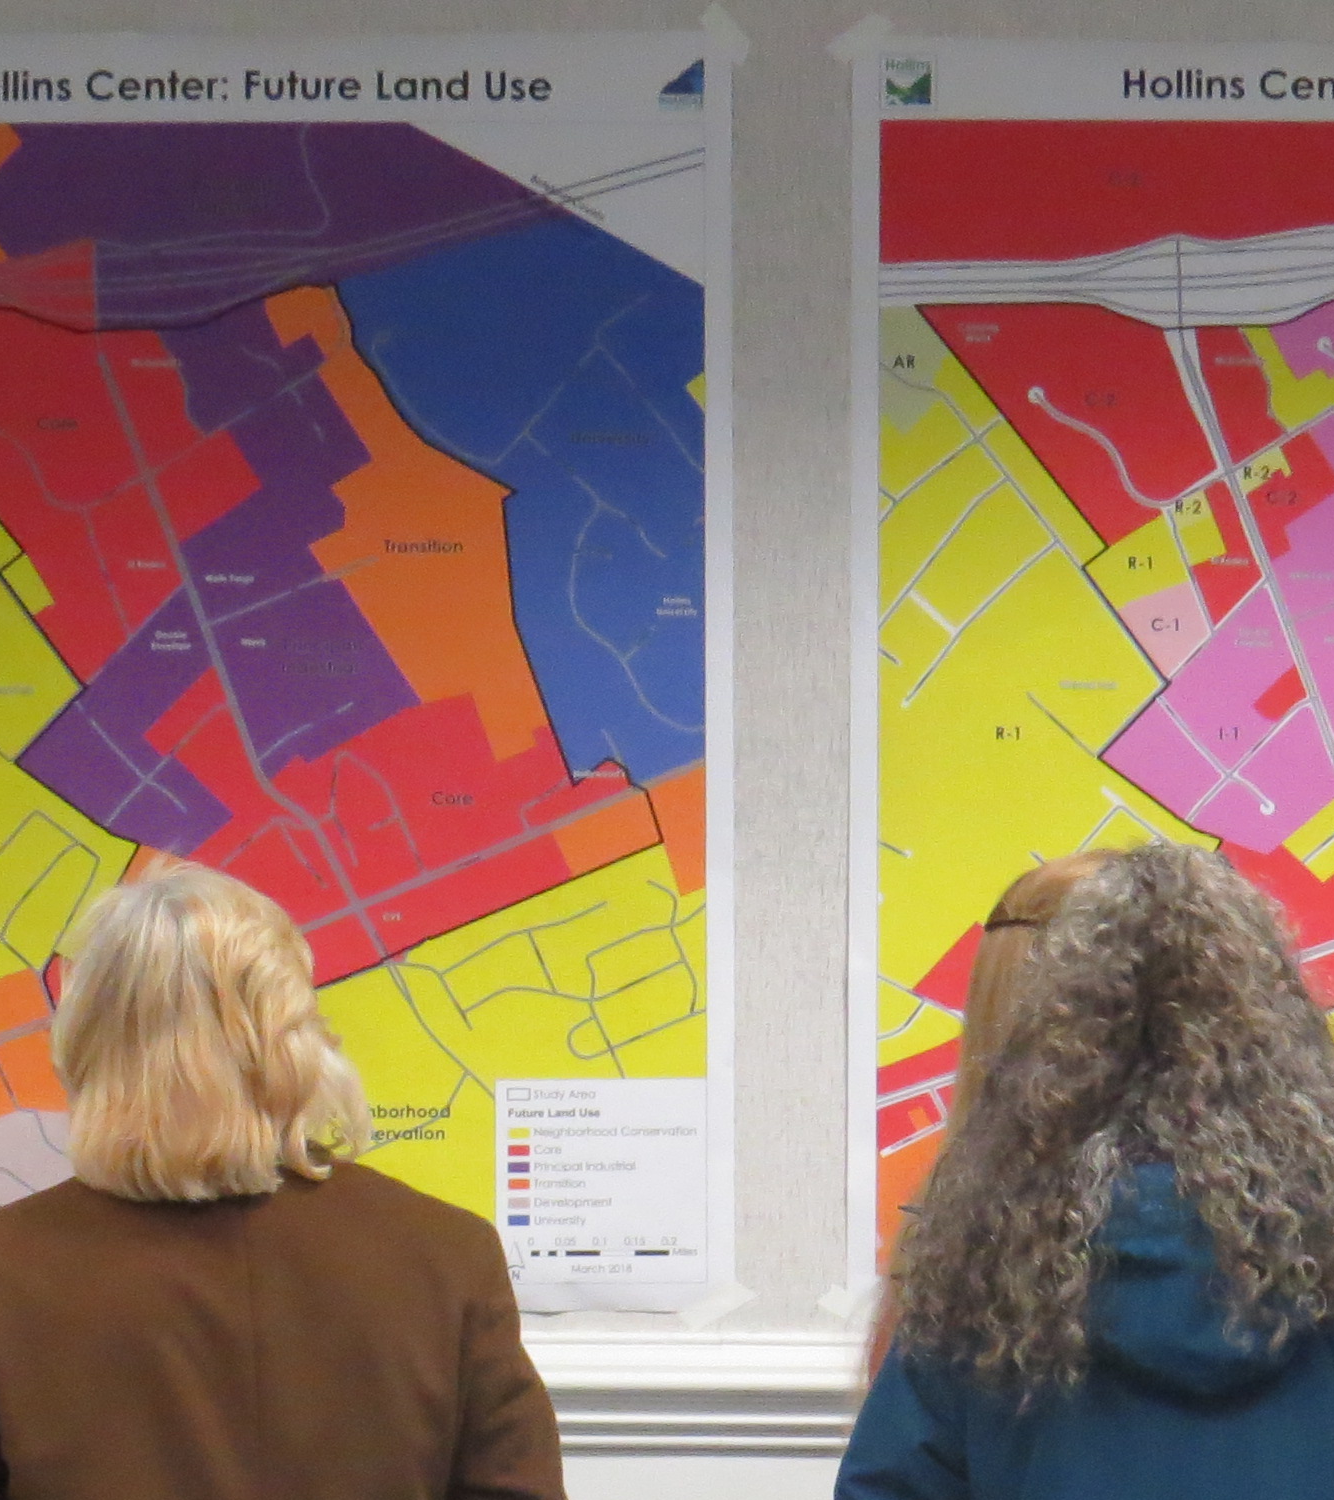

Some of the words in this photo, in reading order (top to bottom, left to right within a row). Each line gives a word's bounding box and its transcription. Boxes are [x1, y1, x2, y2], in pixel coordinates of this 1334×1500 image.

[85, 69, 229, 102] Center:
[244, 69, 362, 102] Future
[376, 69, 469, 102] Land
[484, 70, 552, 102] Use
[1123, 68, 1245, 100] Hollins
[893, 354, 916, 369] AR
[1243, 466, 1270, 480] R-2
[1175, 499, 1202, 514] R-2
[383, 539, 465, 555] Transition
[1128, 556, 1154, 570] R-1
[1151, 618, 1180, 632] C-1
[996, 726, 1021, 741] R-1
[1219, 726, 1239, 741] I-1
[431, 790, 474, 807] Core
[533, 1089, 565, 1101] Study
[569, 1089, 596, 1099] Area
[508, 1108, 545, 1119] Future
[548, 1108, 576, 1118] Land
[579, 1108, 601, 1118] Use
[533, 1127, 618, 1139] Neighborhood
[620, 1126, 698, 1137] Conservation
[533, 1144, 562, 1155] Core
[533, 1162, 583, 1174] Principal
[585, 1160, 636, 1171] Industrial
[533, 1178, 586, 1189] Transition
[533, 1197, 613, 1209] Development
[533, 1215, 586, 1227] University
